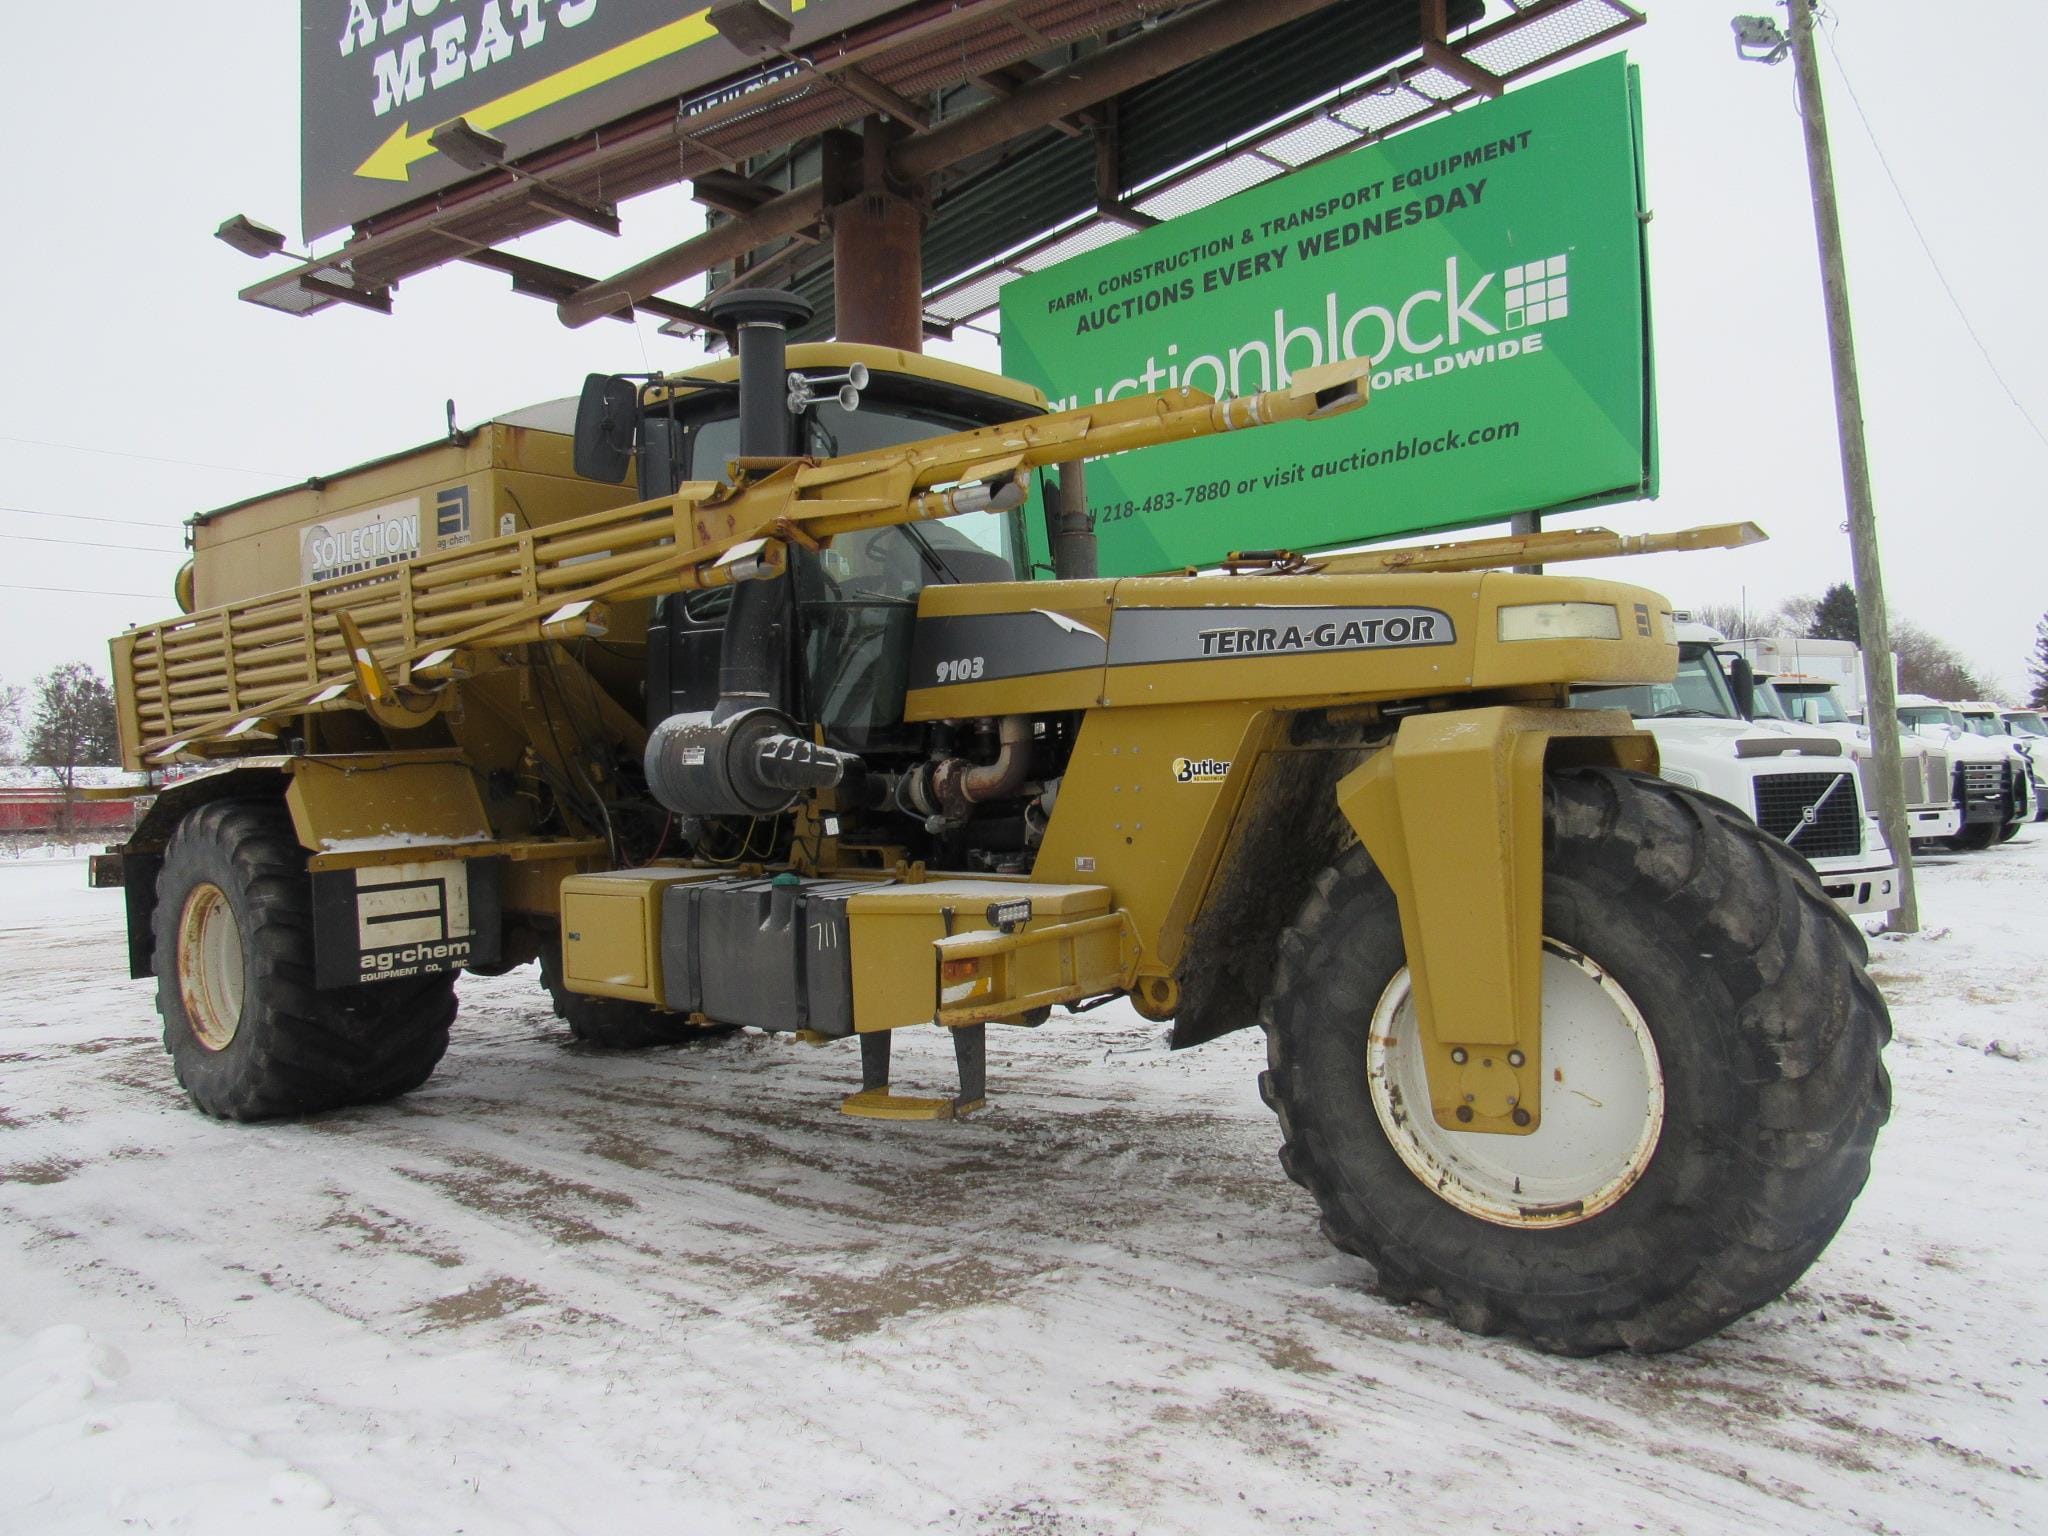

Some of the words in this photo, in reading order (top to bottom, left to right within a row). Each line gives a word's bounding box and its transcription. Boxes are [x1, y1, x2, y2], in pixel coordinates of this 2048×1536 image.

[1048, 287, 1093, 314] FARM,
[1097, 234, 1235, 296] CONSTRUCTION
[1241, 228, 1254, 245] &
[1260, 180, 1385, 239] TRANSPORT
[1392, 130, 1532, 193] EQUIPMENT
[1076, 277, 1195, 336] AUCTIONS
[1203, 245, 1289, 293] EVERY
[1297, 178, 1488, 261] WEDNESDAY
[1366, 333, 1543, 391] ORLDWIDE
[1102, 478, 1231, 523] 218-483-7880
[1236, 477, 1258, 495] or
[1263, 463, 1305, 489] visit
[1310, 421, 1520, 479] auctionblock.com
[311, 514, 418, 571] SOILECTION
[1198, 616, 1436, 655] TERRA-GATOR
[936, 656, 985, 683] 9103
[1178, 759, 1230, 782] Butler
[360, 966, 419, 982] EQUIPMENT
